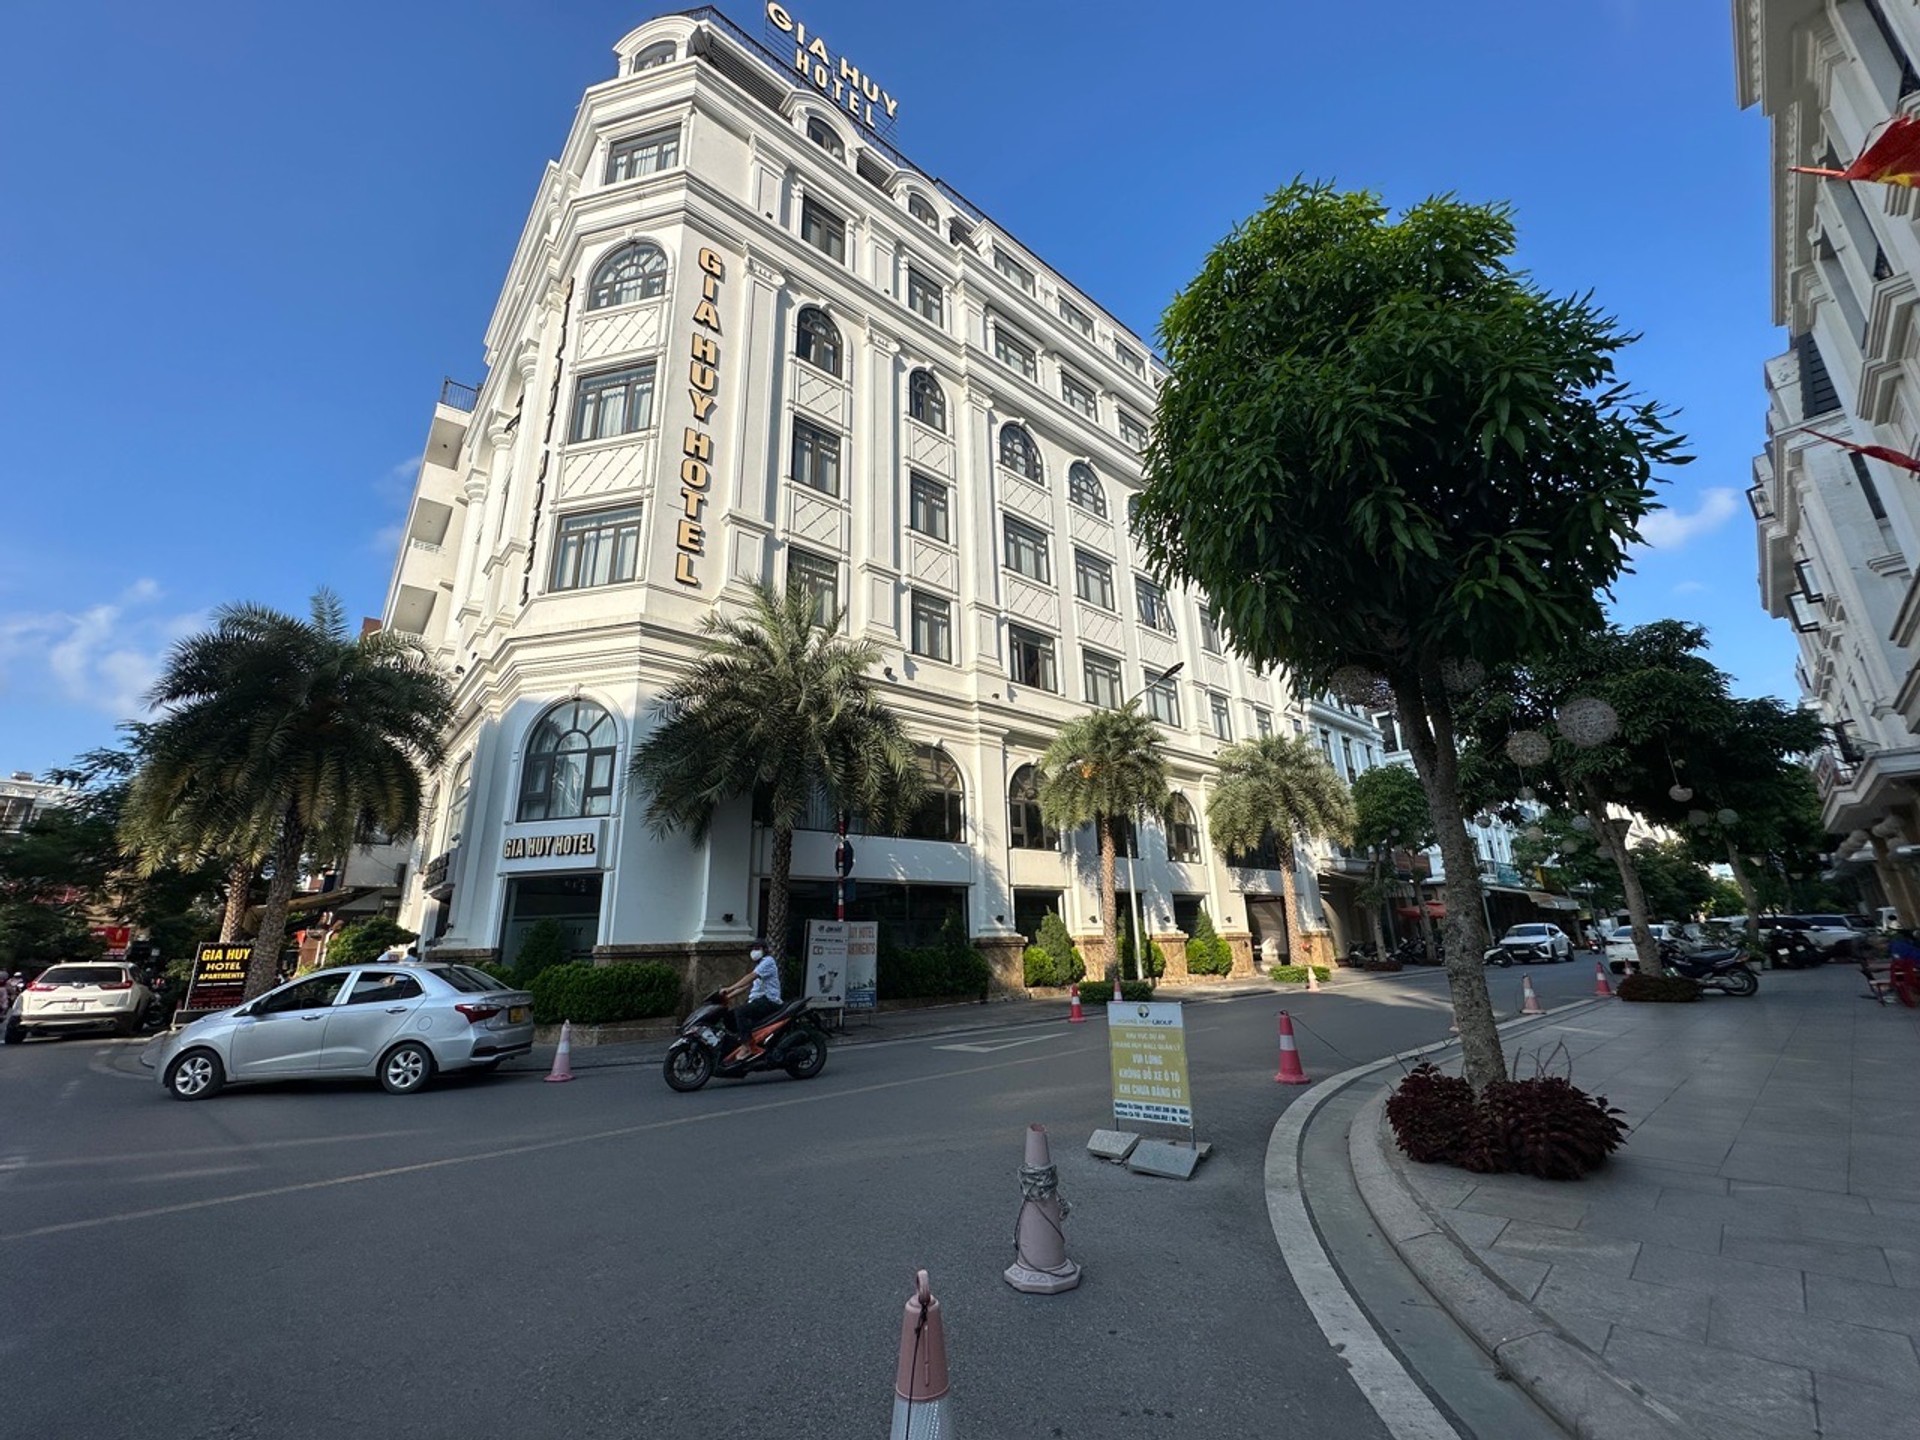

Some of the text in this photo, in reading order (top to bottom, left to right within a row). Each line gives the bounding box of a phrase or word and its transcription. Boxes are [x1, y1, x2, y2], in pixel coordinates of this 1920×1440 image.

[767, 1, 898, 118] GIA HUY
[796, 48, 875, 129] HOTEL
[675, 247, 723, 586] GIA HUY HOTEL
[503, 832, 595, 859] GIA HUY HOTEL
[201, 948, 251, 961] GIA HUY
[206, 962, 241, 971] HOTEL
[198, 972, 246, 980] APARTMENTS
